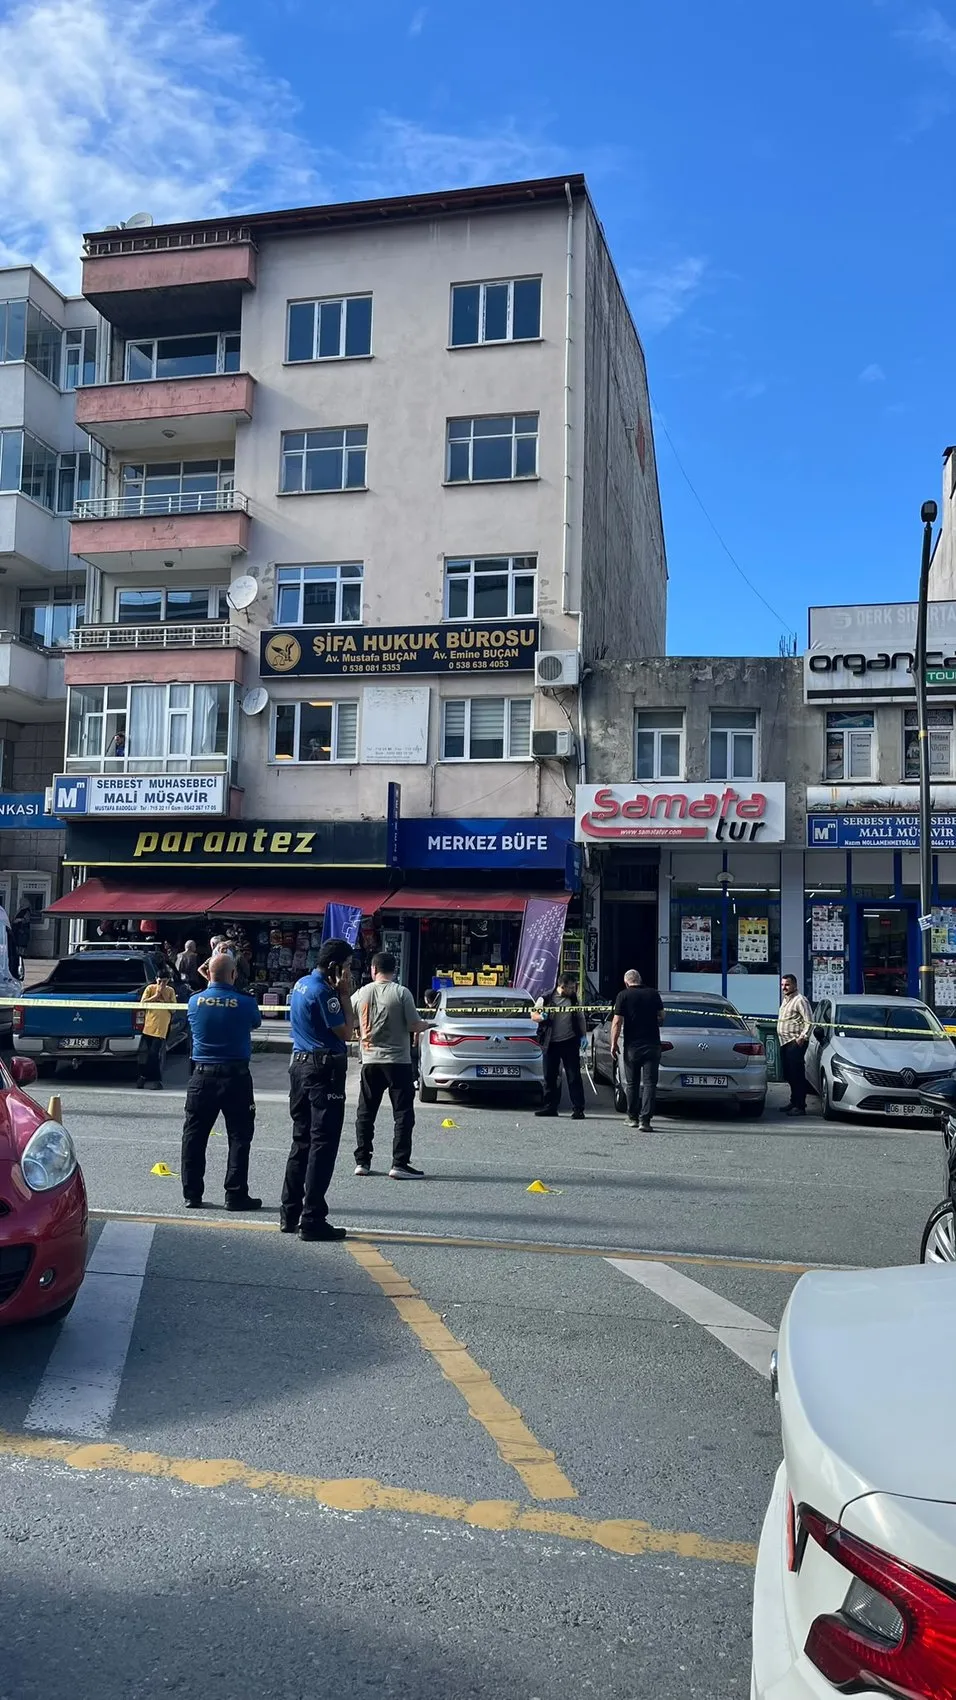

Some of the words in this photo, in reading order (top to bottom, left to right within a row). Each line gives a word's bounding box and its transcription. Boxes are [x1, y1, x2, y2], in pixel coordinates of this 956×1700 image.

[312, 632, 357, 656] ŞİFA
[364, 632, 440, 651] HUKUK
[446, 628, 535, 648] BÜROSU
[326, 652, 340, 662] Av.
[342, 652, 380, 662] Mustafa
[383, 652, 417, 663] BUÇAN
[433, 650, 448, 660] Av.
[450, 650, 480, 659] Emine
[483, 648, 519, 660] BUÇAN
[96, 778, 142, 789] SERBEST
[149, 776, 217, 788] MUHASEBECİ
[104, 791, 138, 803] MALİ
[144, 791, 208, 805] MÜŞAVİR
[843, 817, 892, 825] SERBEST
[715, 816, 765, 841] tur
[859, 828, 893, 837] MALİ
[134, 828, 318, 858] parantez
[428, 836, 497, 851] MERKEZ
[502, 833, 548, 850] BÜFE
